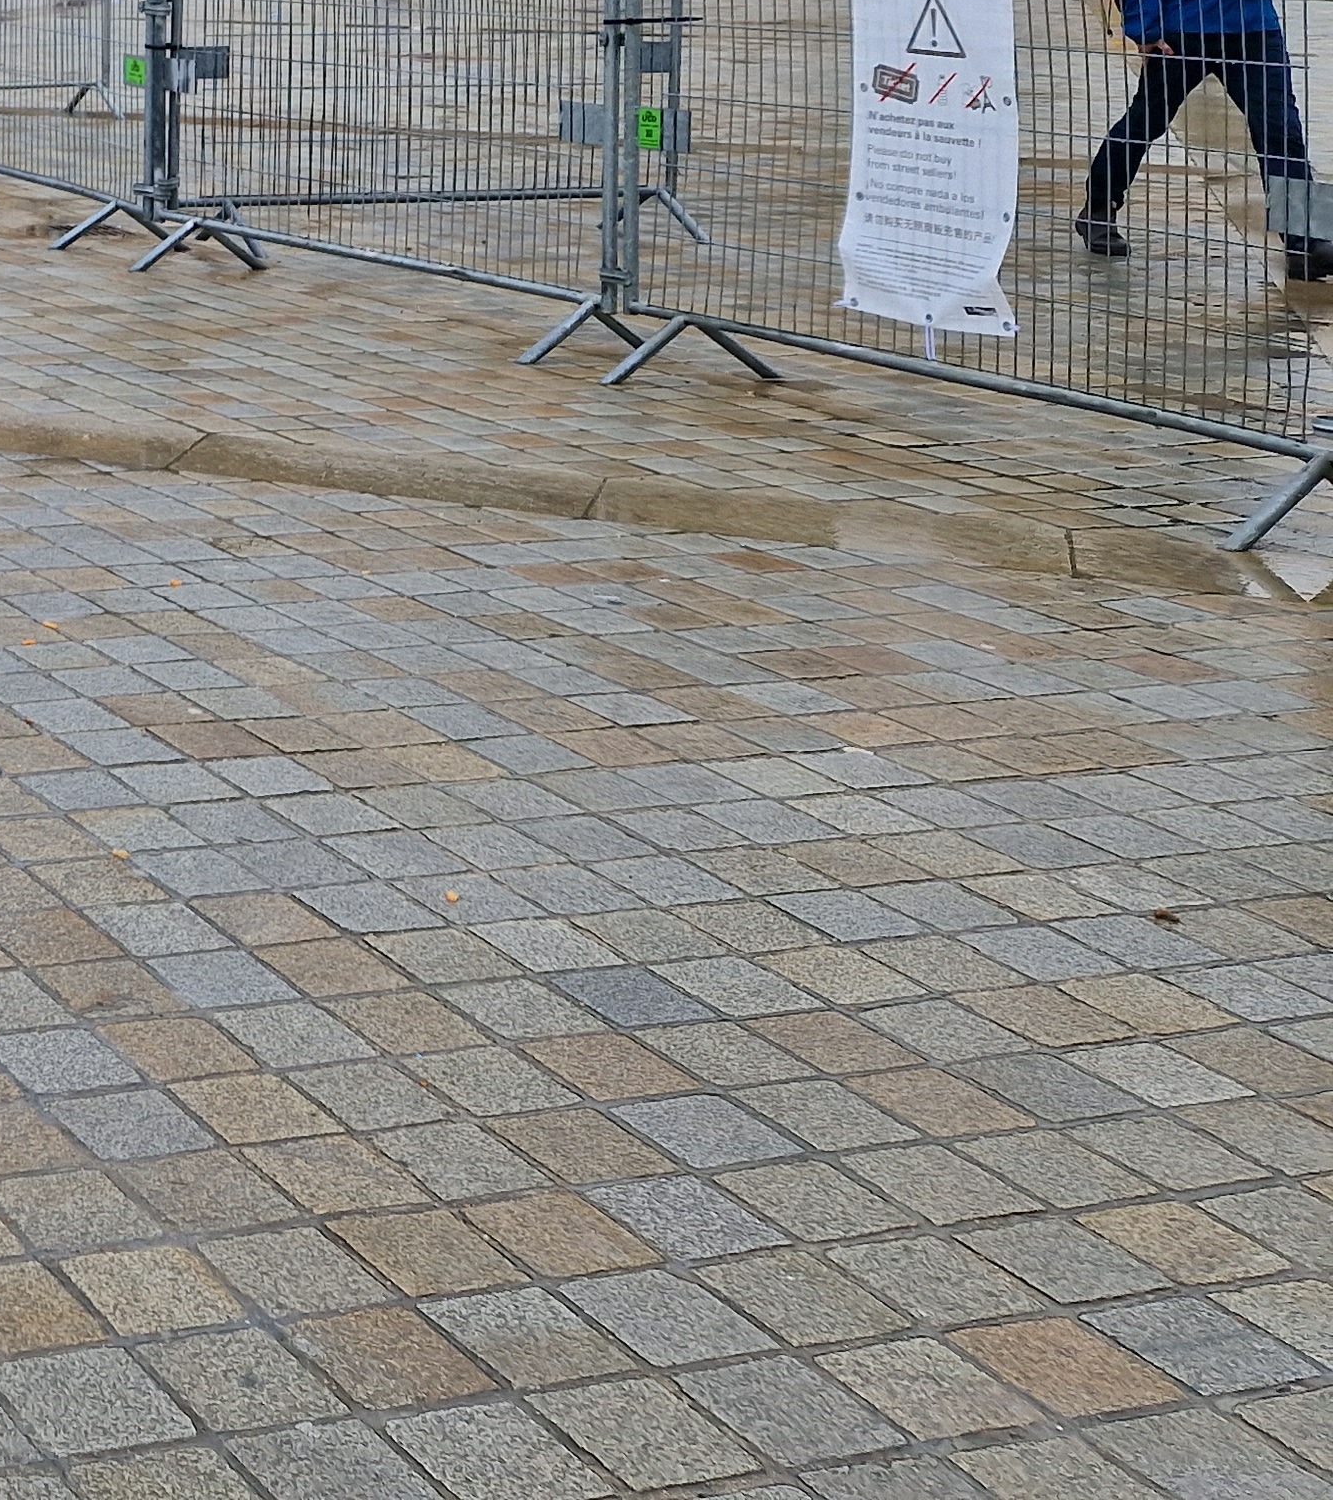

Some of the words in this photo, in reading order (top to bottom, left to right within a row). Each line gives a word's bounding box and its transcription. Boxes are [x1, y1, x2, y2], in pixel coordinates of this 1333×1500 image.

[868, 109, 916, 126] N'achetez
[917, 117, 934, 128] pas
[937, 119, 956, 130] aux
[868, 125, 913, 140] vendeurs
[923, 131, 932, 142] la
[933, 133, 976, 148] sauvette
[867, 158, 891, 171] from
[892, 163, 920, 175] street
[899, 150, 914, 160] do
[915, 152, 932, 162] not
[934, 153, 953, 167] buy
[865, 194, 922, 210] vendedores
[885, 182, 924, 196] compre
[925, 186, 950, 200] nada
[960, 192, 975, 203] los
